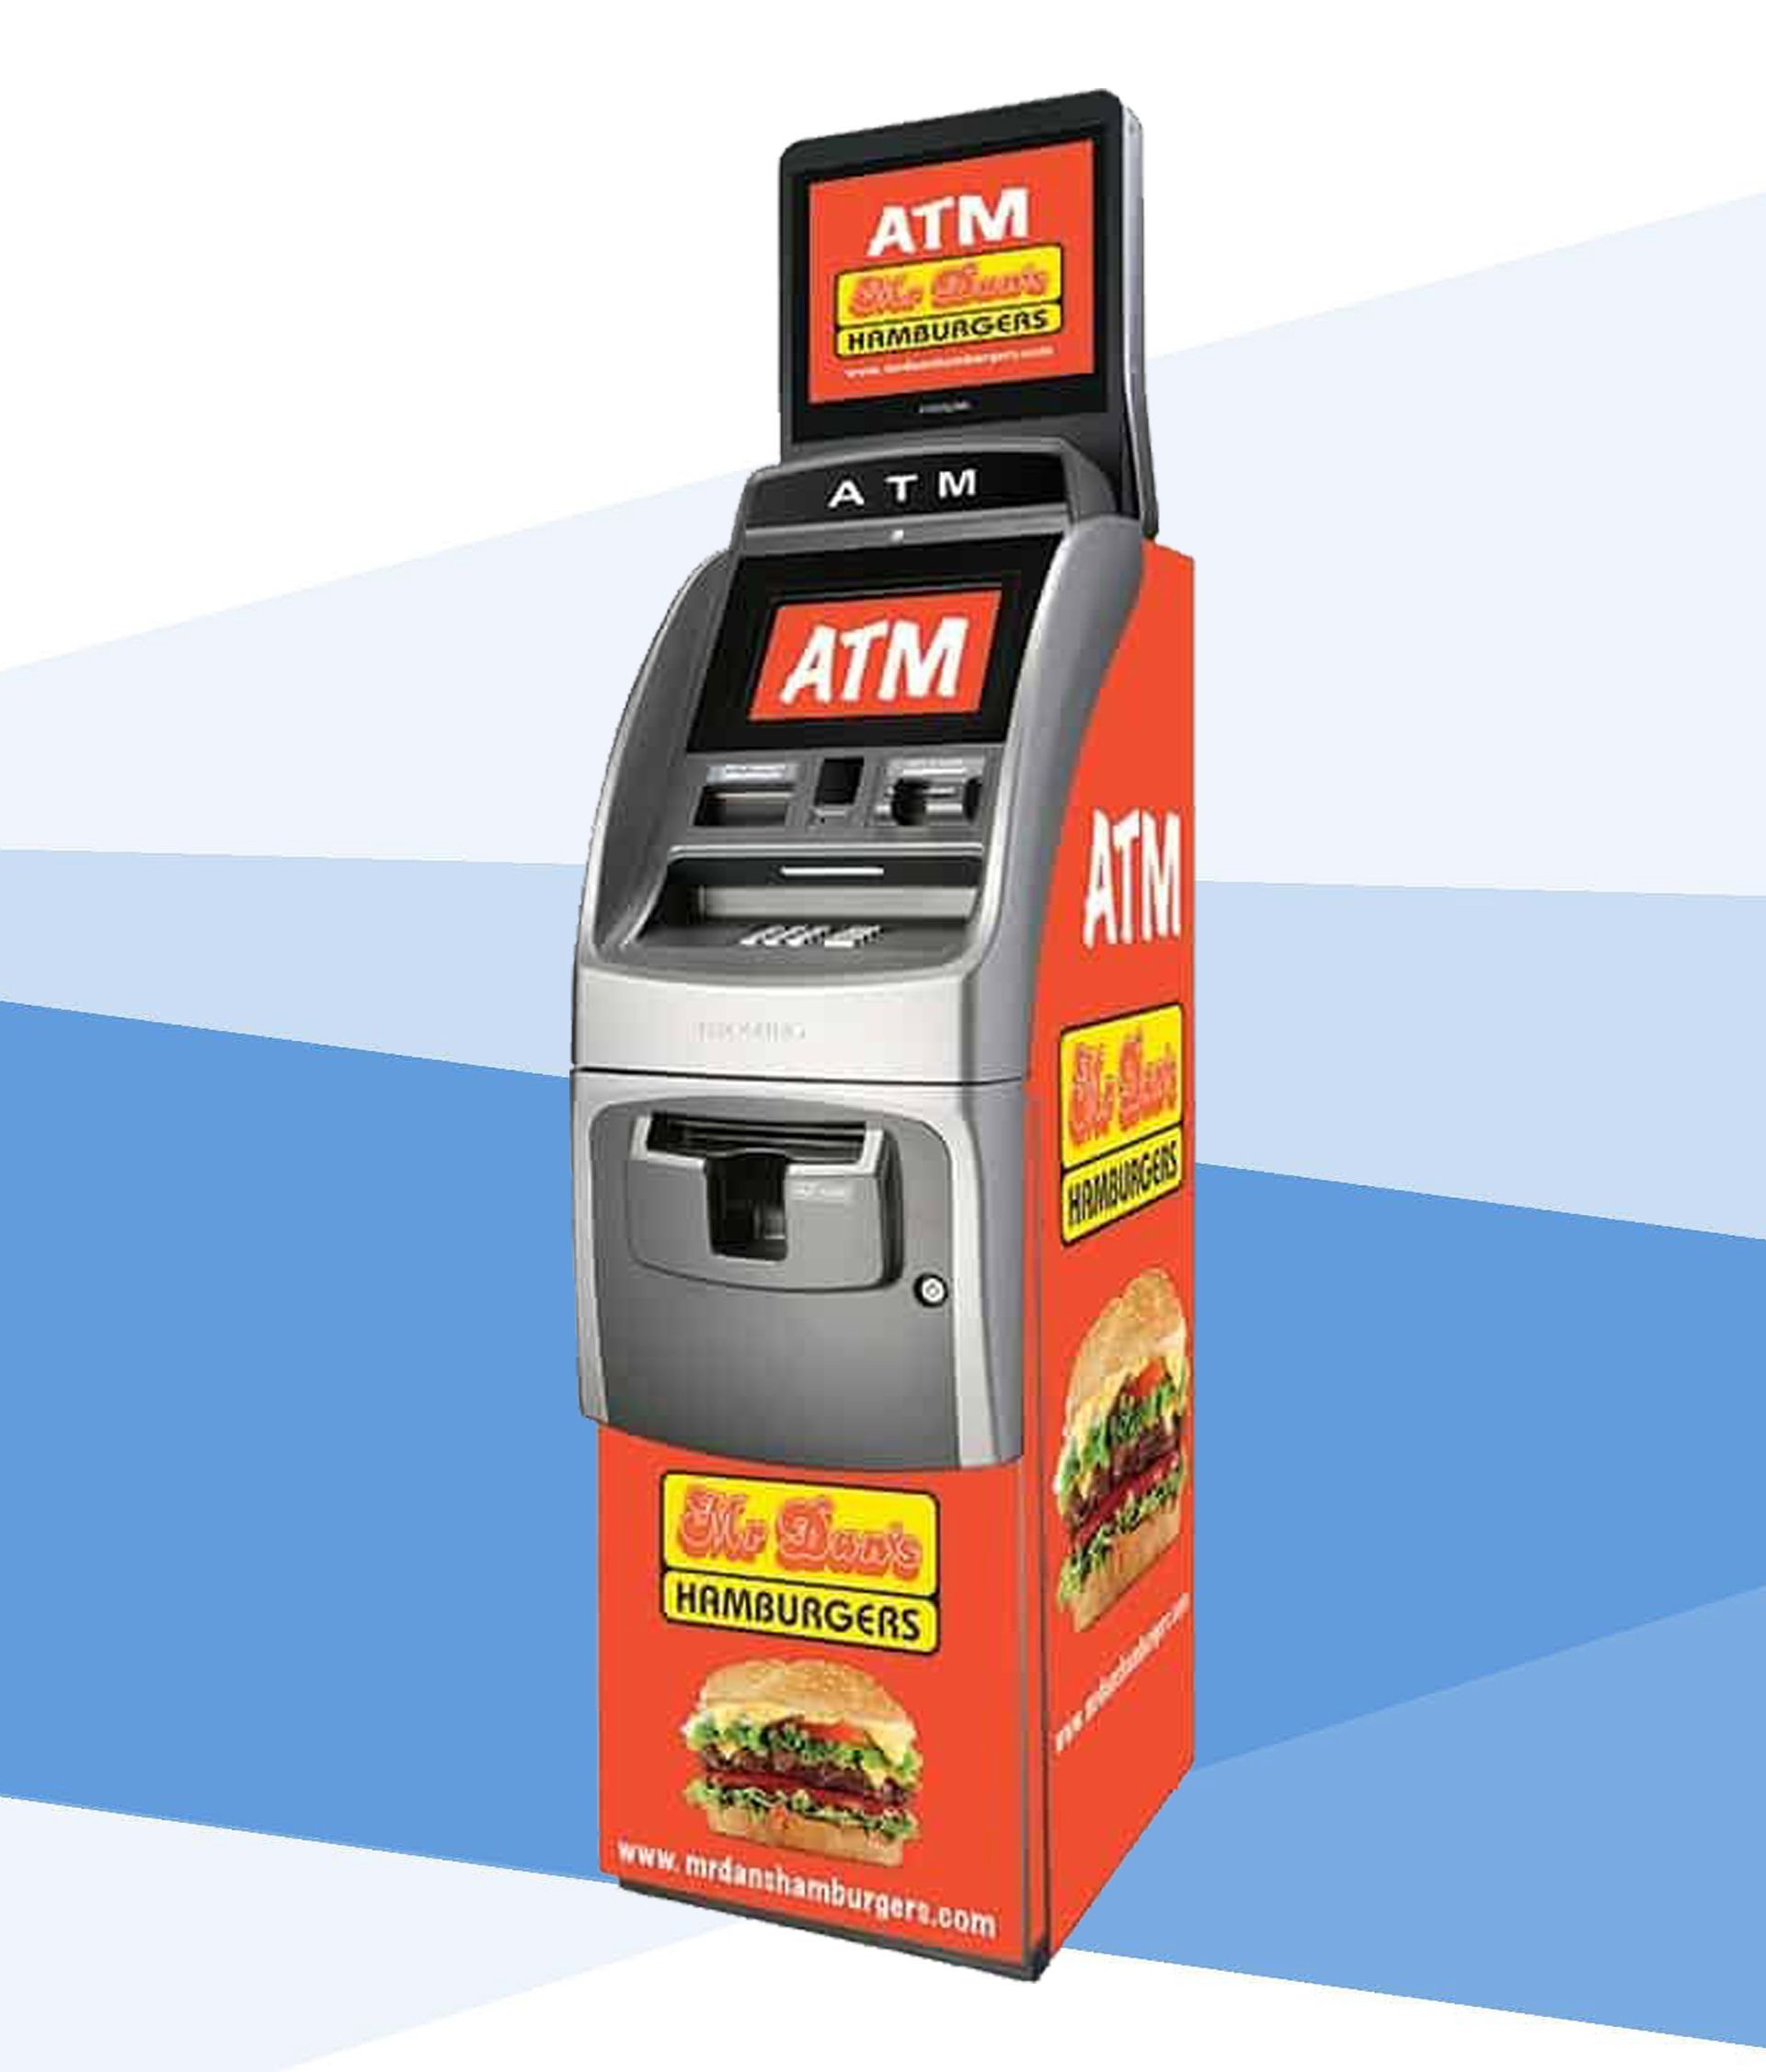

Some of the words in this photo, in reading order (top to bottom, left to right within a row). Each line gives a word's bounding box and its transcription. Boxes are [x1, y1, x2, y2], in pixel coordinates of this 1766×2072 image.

[867, 187, 1029, 257] ATM
[847, 308, 1049, 352] HAMBURGERS
[779, 617, 969, 704] ATM
[1083, 807, 1181, 949] ATM
[1067, 1139, 1177, 1227] HAMBURGERS
[676, 1580, 921, 1641] HAMBURGERS
